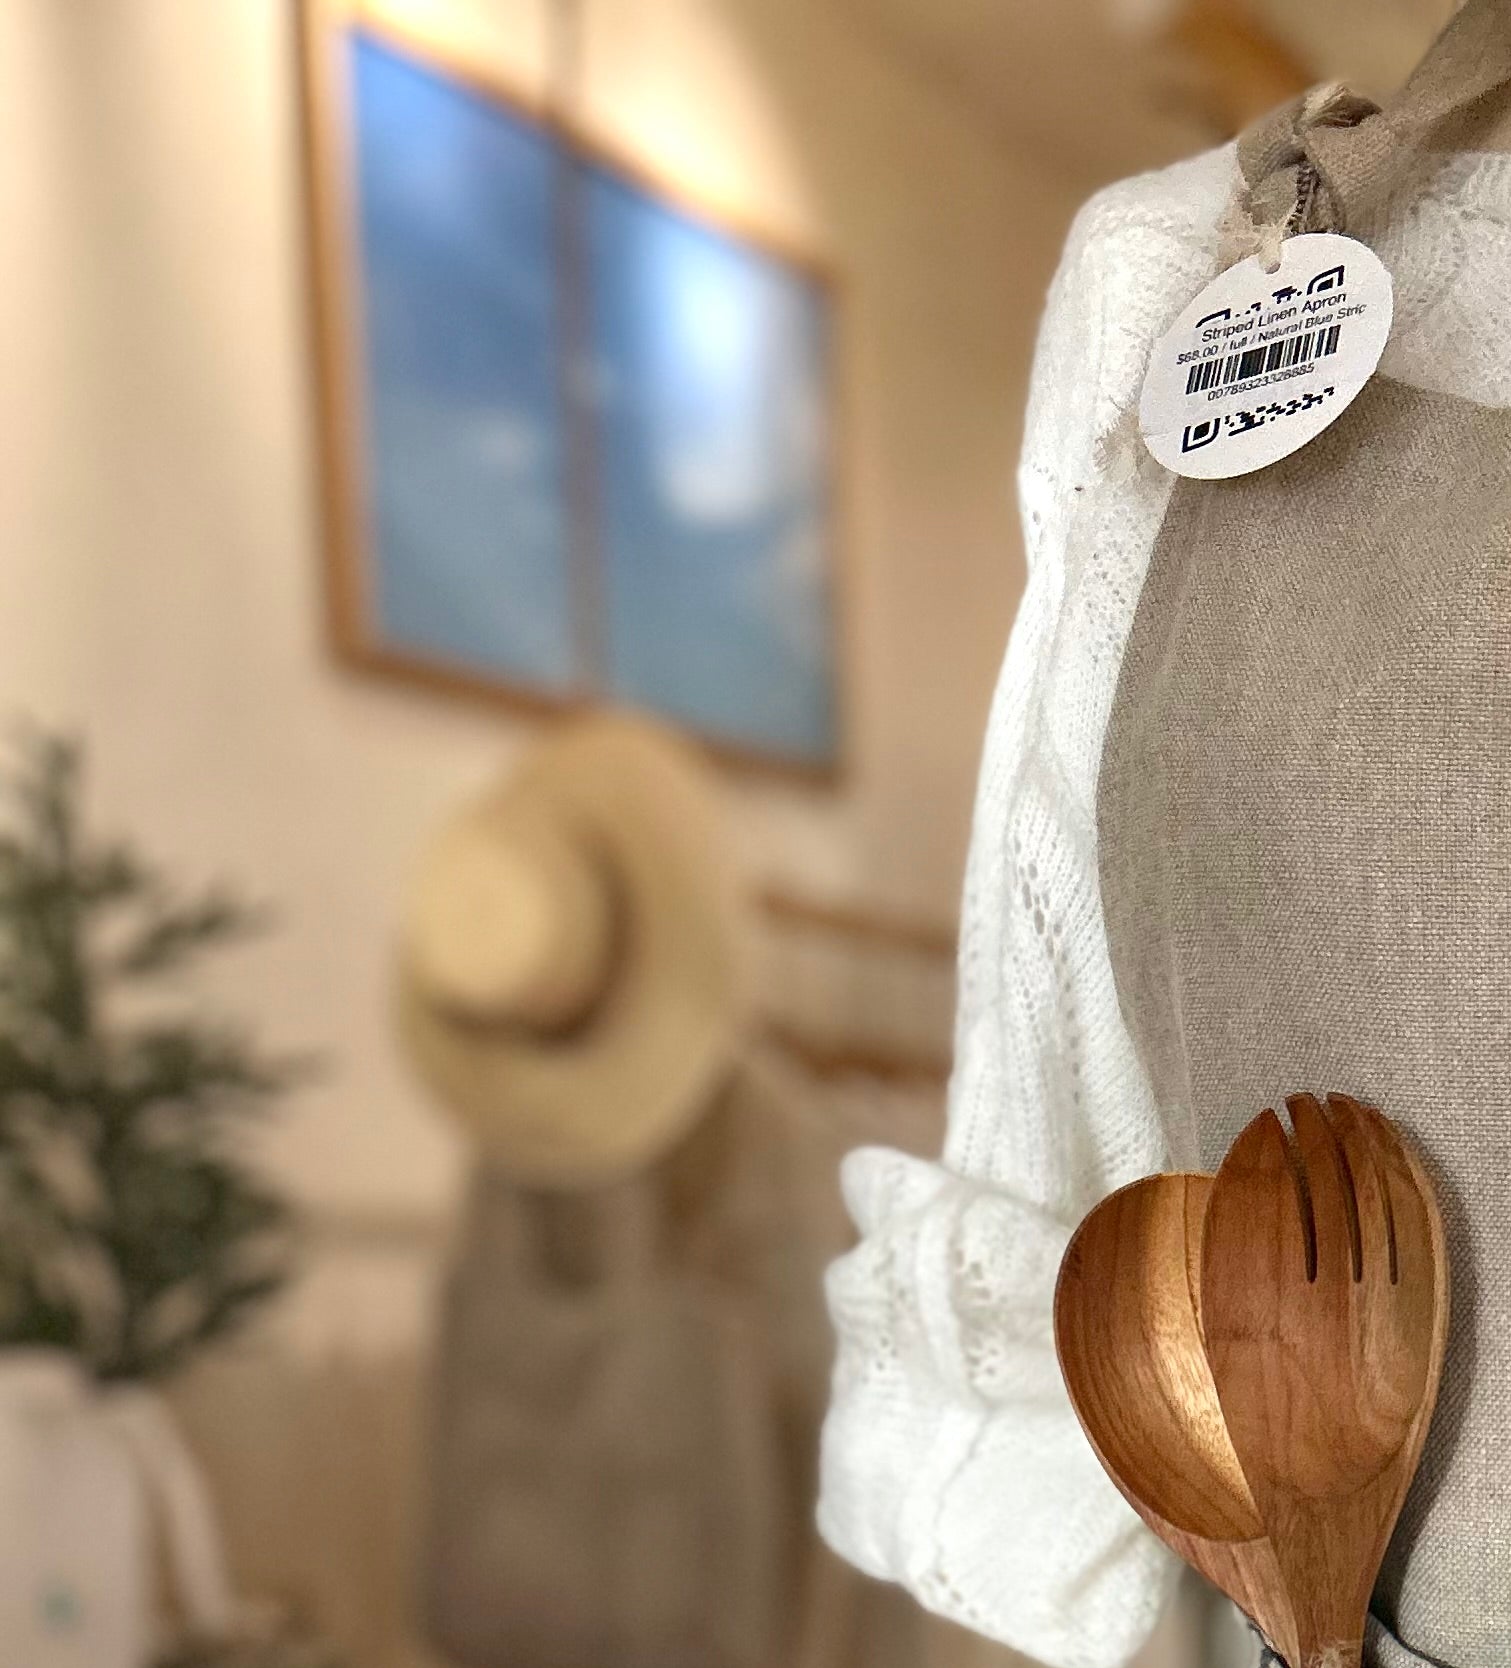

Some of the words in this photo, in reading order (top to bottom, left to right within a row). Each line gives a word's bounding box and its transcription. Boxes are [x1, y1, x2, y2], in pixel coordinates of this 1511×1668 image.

[1201, 318, 1255, 342] Striped
[1258, 307, 1297, 328] Linen
[1301, 293, 1346, 314] Apron
[1258, 320, 1303, 342] Natural
[1305, 314, 1334, 329] Blue
